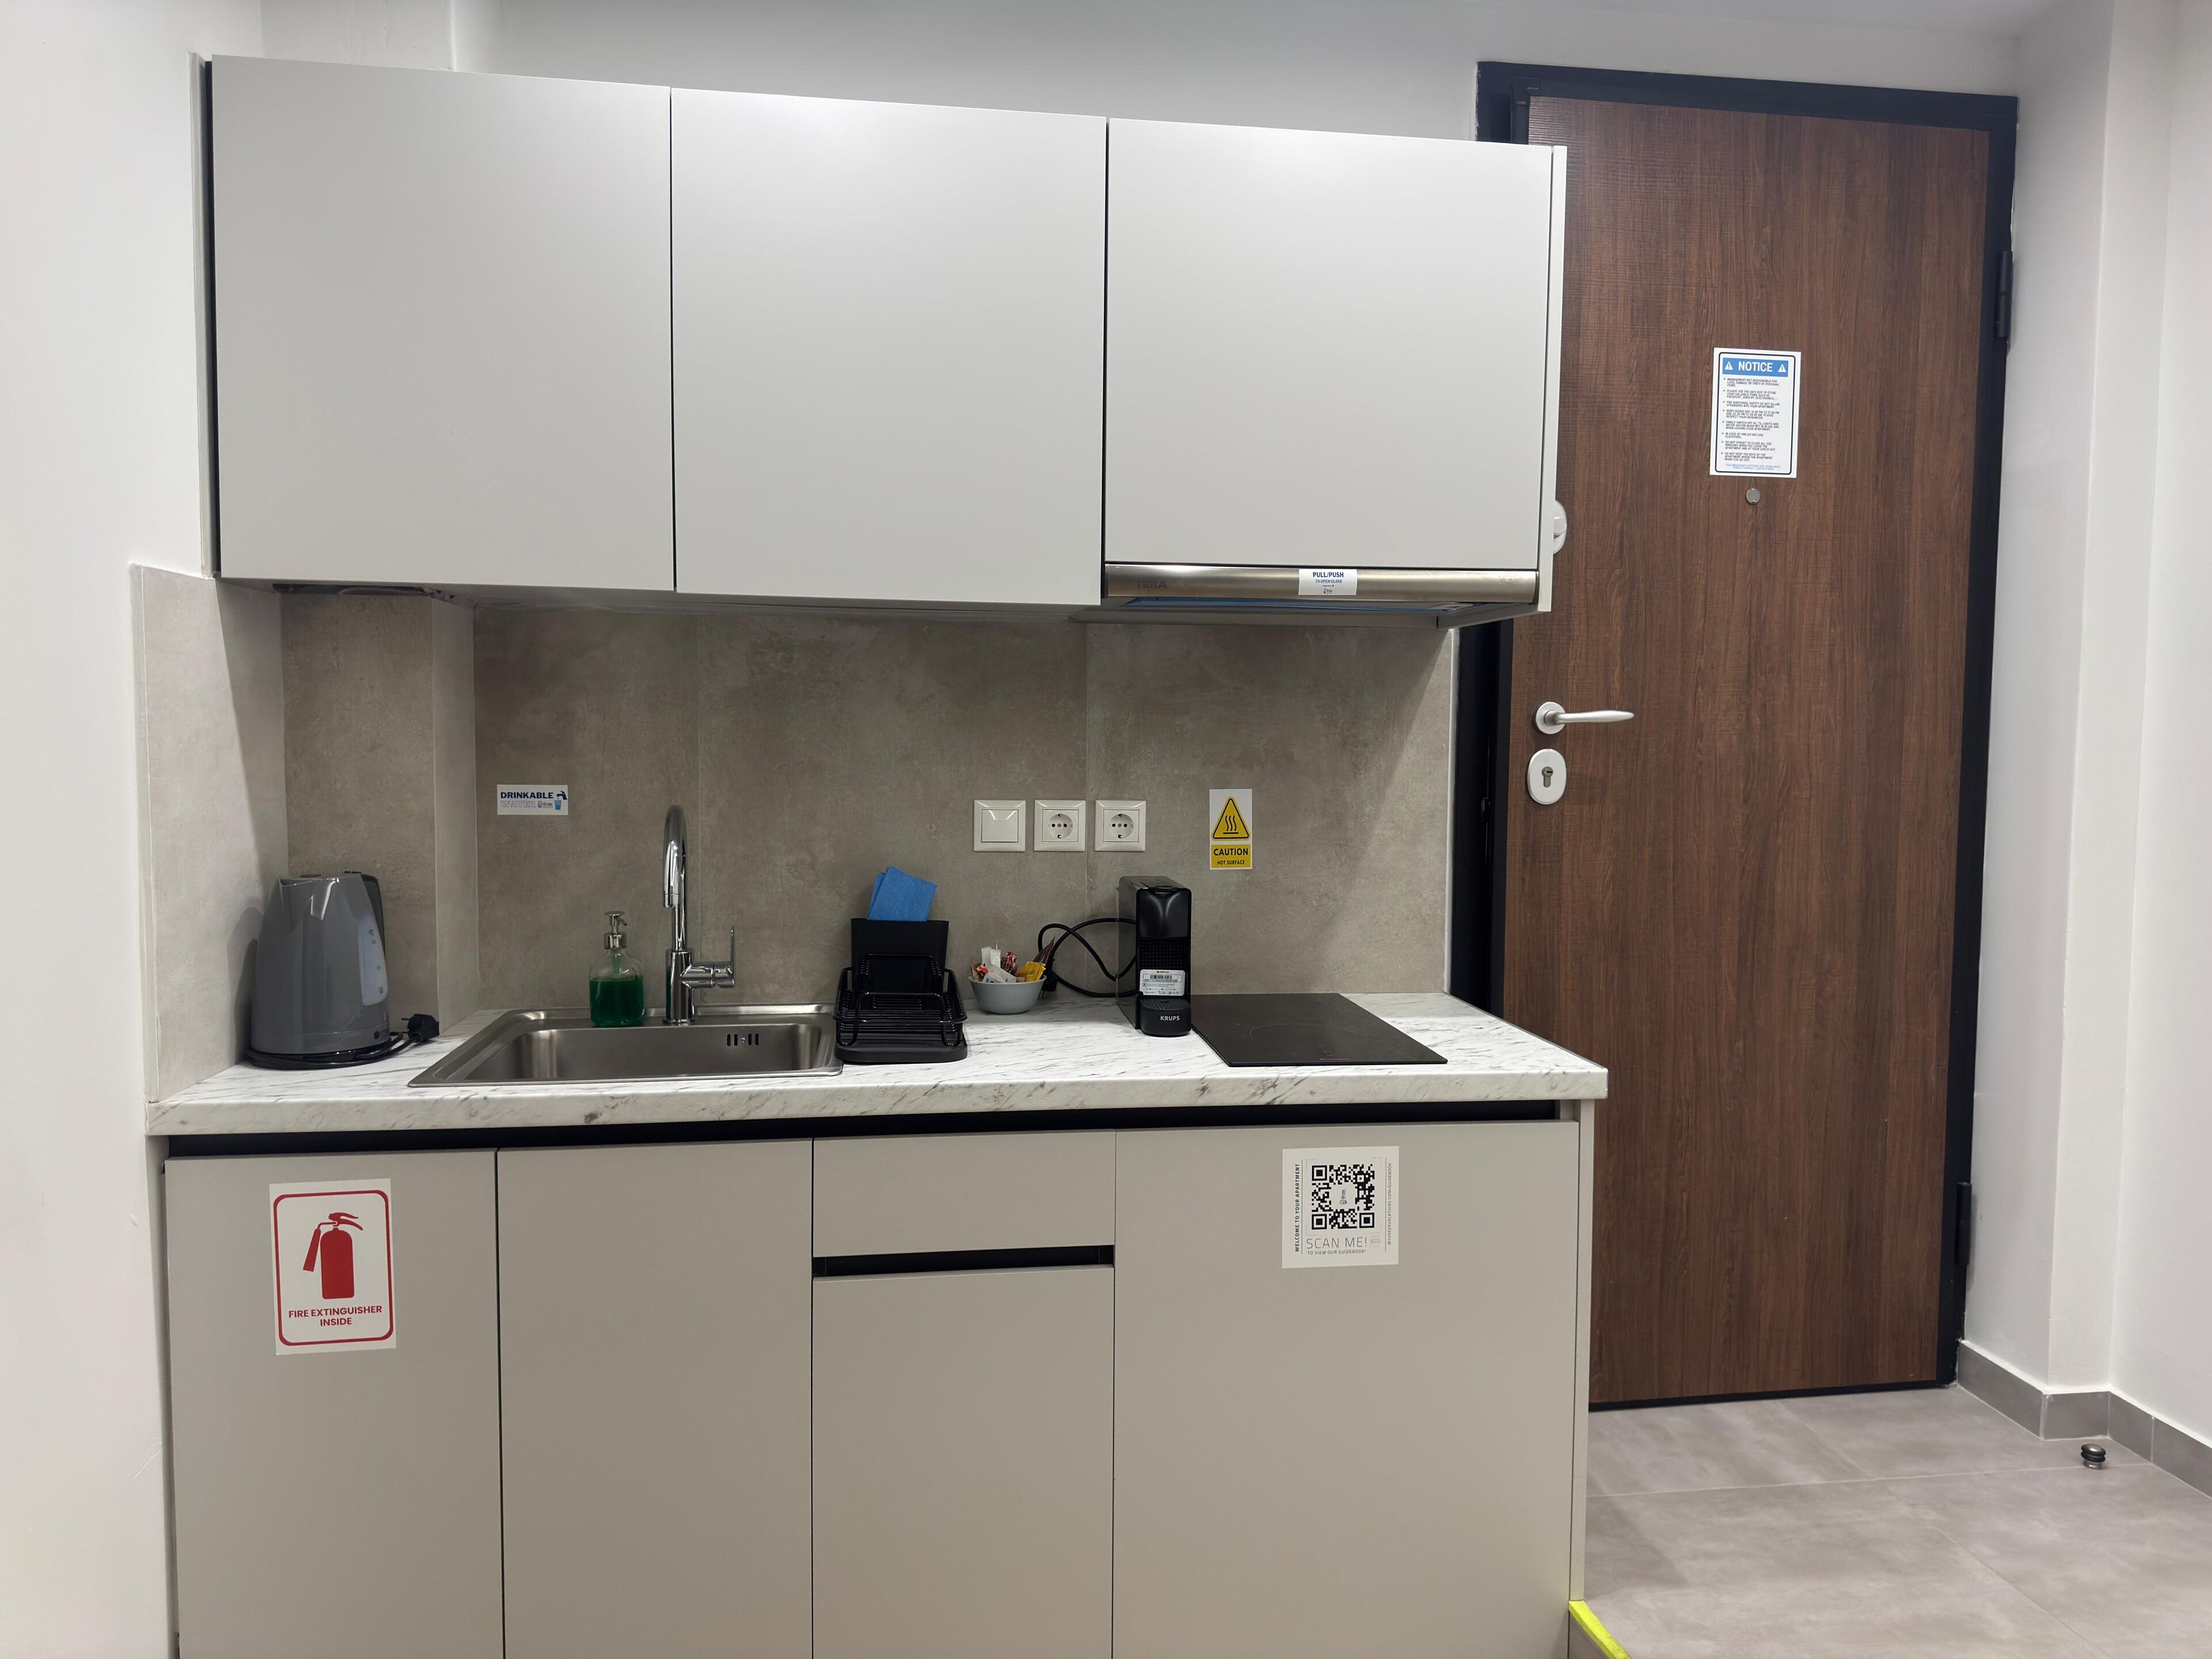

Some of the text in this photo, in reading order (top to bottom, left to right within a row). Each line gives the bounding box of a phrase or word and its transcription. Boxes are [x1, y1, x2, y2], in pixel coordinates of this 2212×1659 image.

[1738, 361, 1773, 372] NOTICE
[1214, 848, 1248, 856] CAUTION
[1306, 1237, 1367, 1249] SCAN ME!
[289, 1305, 382, 1318] FIRE EXTINGUISHER
[320, 1317, 352, 1327] INSIDE
